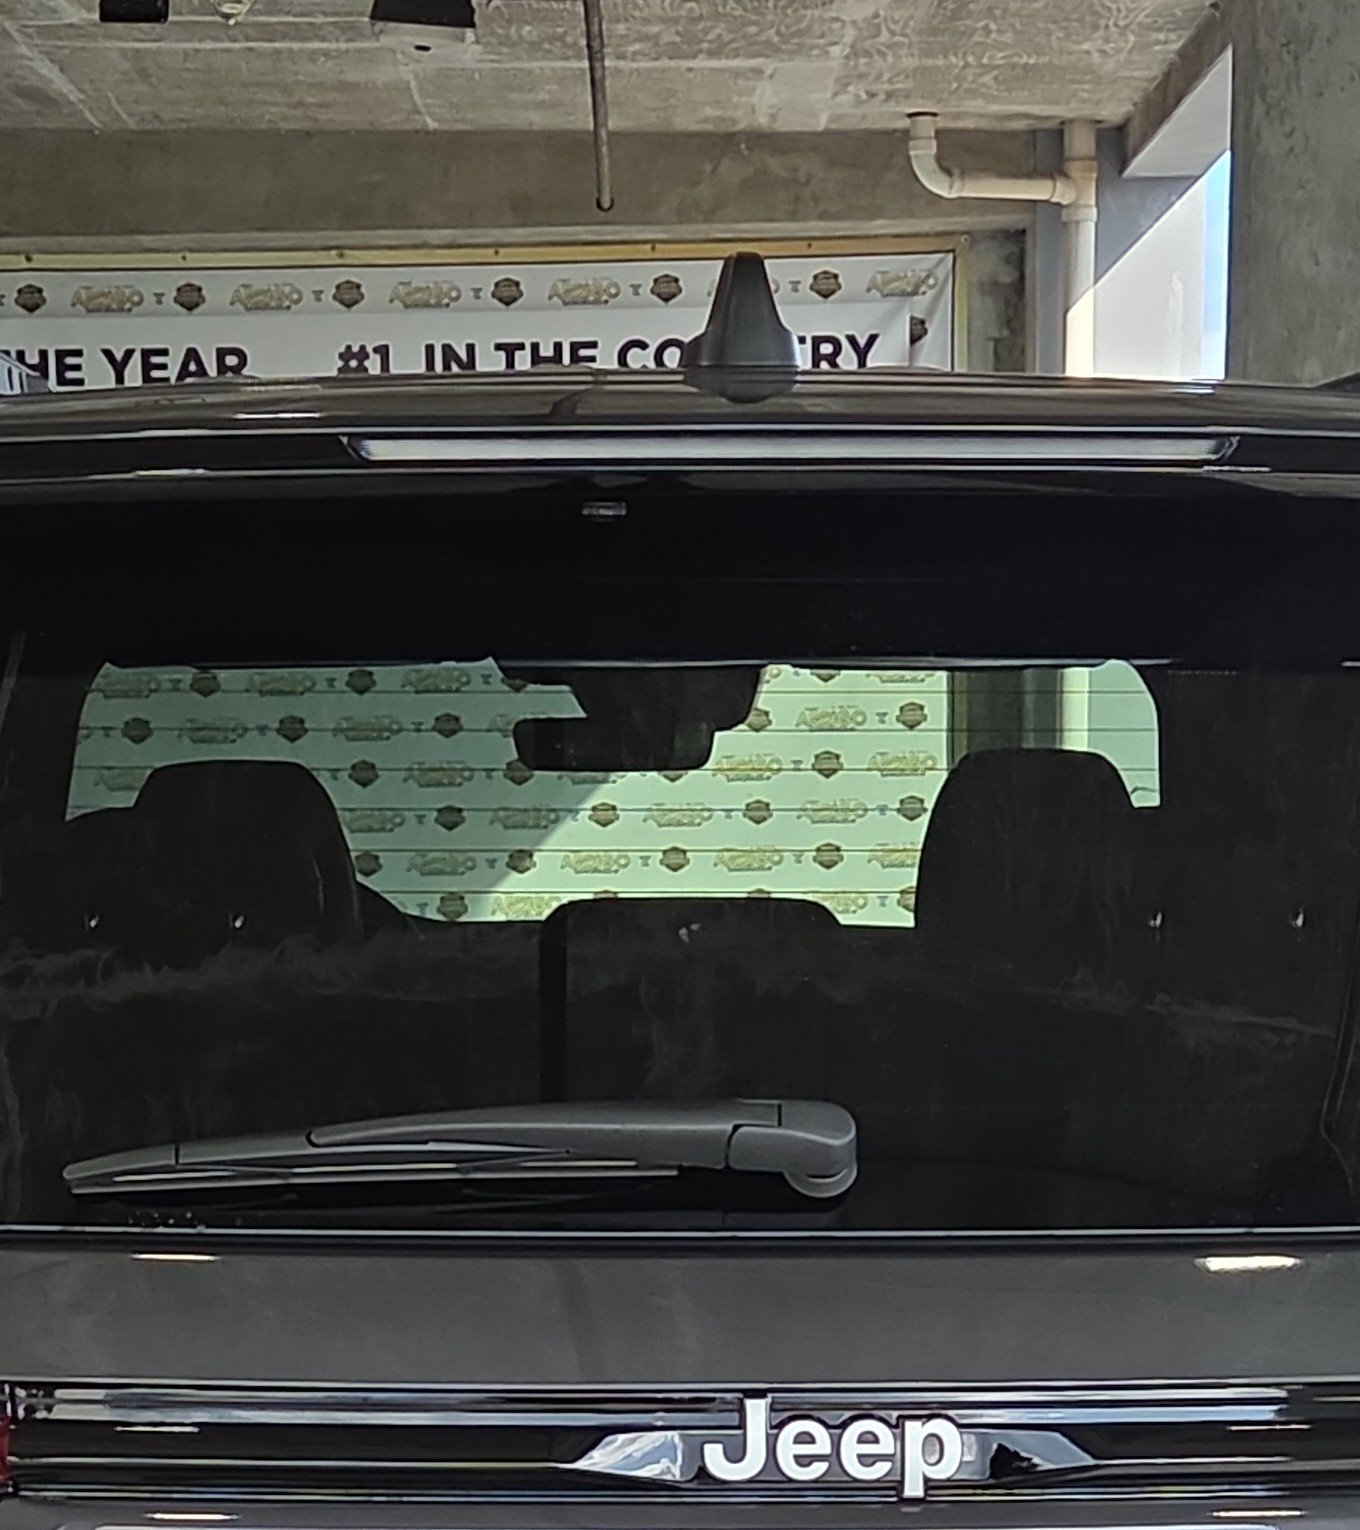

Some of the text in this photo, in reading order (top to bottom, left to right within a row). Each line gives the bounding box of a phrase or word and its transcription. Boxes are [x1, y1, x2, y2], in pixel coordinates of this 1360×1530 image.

[1, 347, 85, 387] HE
[100, 346, 249, 386] YEAR
[338, 343, 390, 376] #1
[424, 342, 476, 373] IN
[494, 340, 599, 371] THE
[702, 1397, 963, 1499] Jeep
